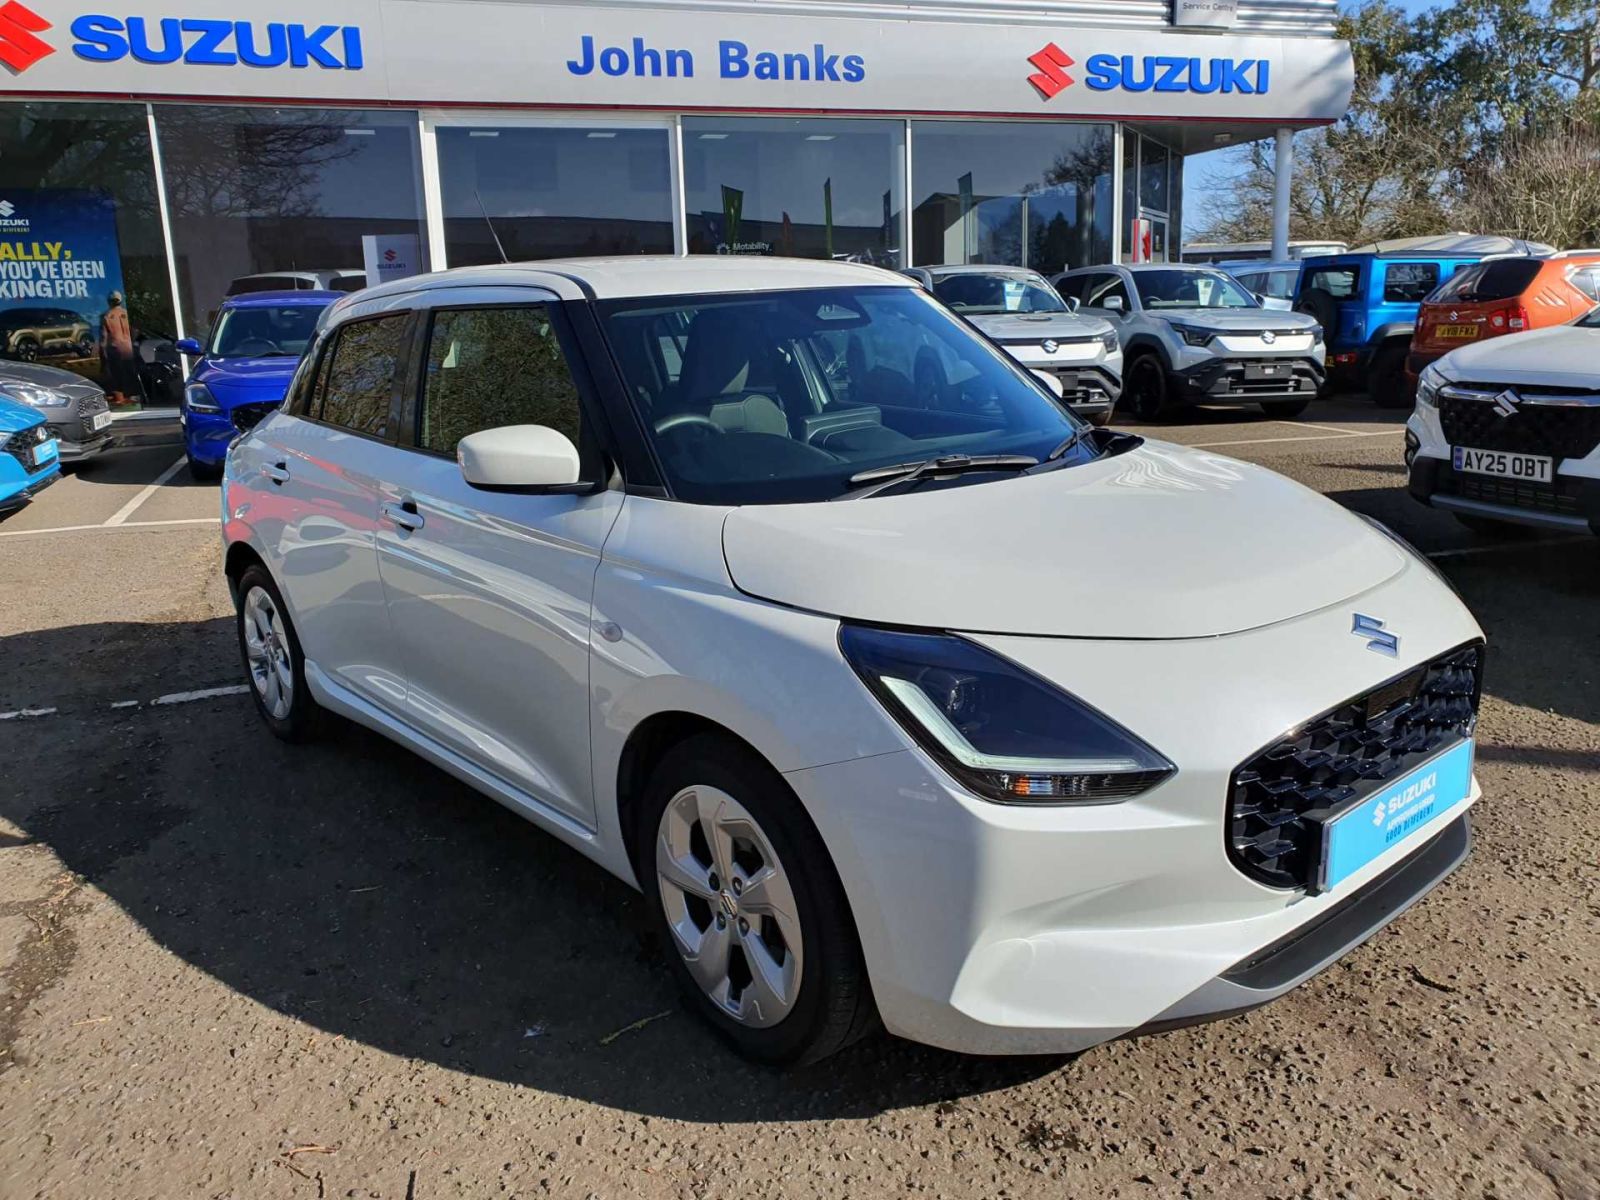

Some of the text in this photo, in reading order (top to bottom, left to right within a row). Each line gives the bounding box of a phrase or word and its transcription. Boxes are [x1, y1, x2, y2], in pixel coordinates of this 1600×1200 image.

[1183, 2, 1211, 11] Service
[71, 14, 364, 70] SUZUKI
[567, 35, 866, 82] John Banks
[1085, 53, 1270, 95] SUZUKI
[733, 243, 770, 252] Motability
[61, 261, 105, 279] BEEN
[55, 279, 89, 298] FOR
[1464, 451, 1548, 478] AY25 OBT
[1388, 772, 1437, 814] SUZUKI
[1386, 825, 1402, 843] GOOD
[1403, 803, 1434, 832] DIFFERENT
